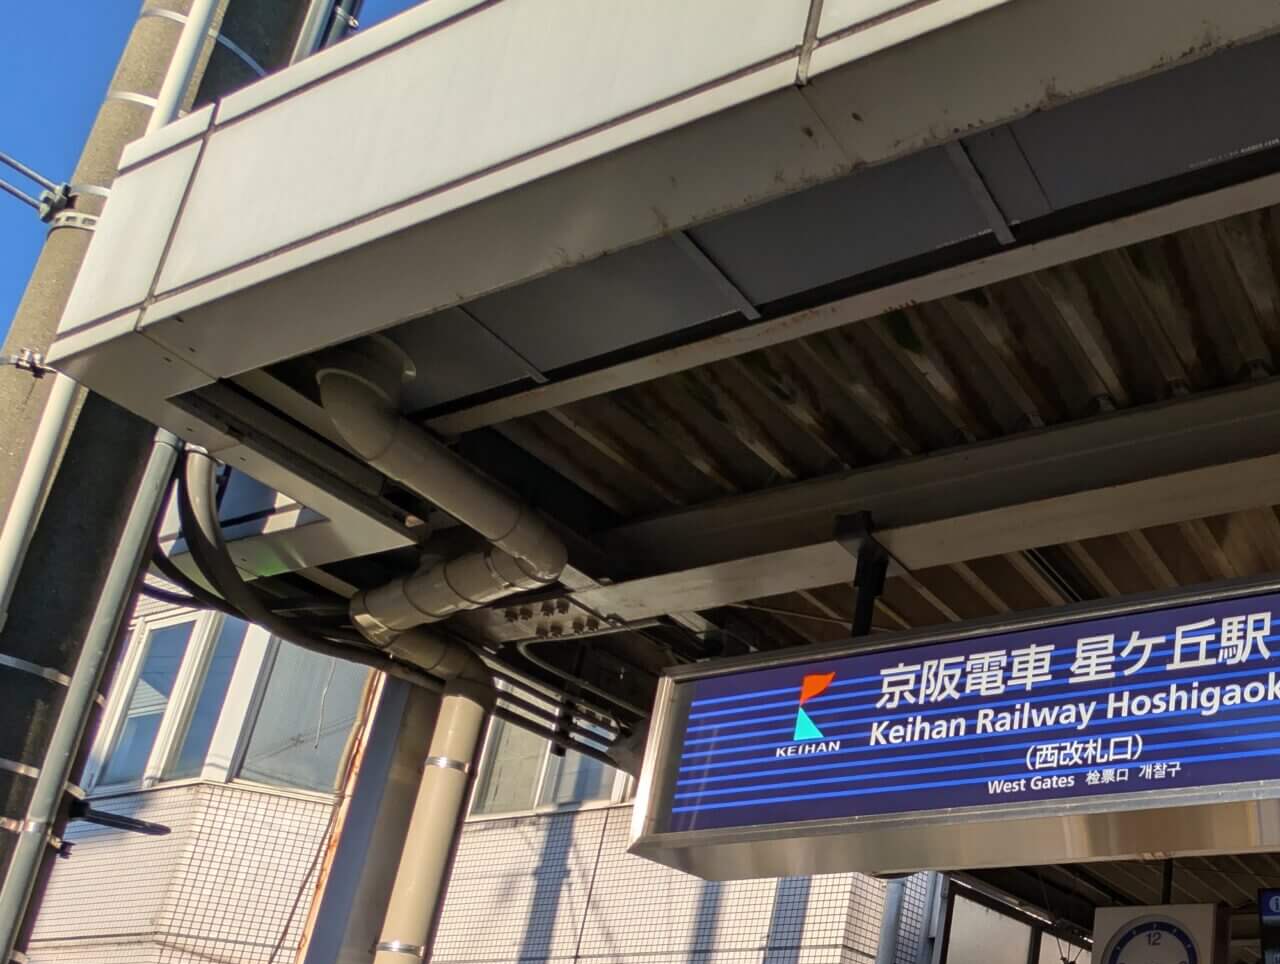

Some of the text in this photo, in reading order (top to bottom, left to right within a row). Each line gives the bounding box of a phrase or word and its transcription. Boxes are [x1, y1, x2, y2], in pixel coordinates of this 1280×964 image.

[876, 643, 1056, 710] 京阪電車
[870, 714, 966, 747] Keihan
[976, 699, 1096, 736] Railway
[775, 741, 841, 758] KEIHAN
[1138, 761, 1181, 780] 개찰구
[987, 774, 1075, 795] West Gates
[1146, 932, 1161, 946] 12
